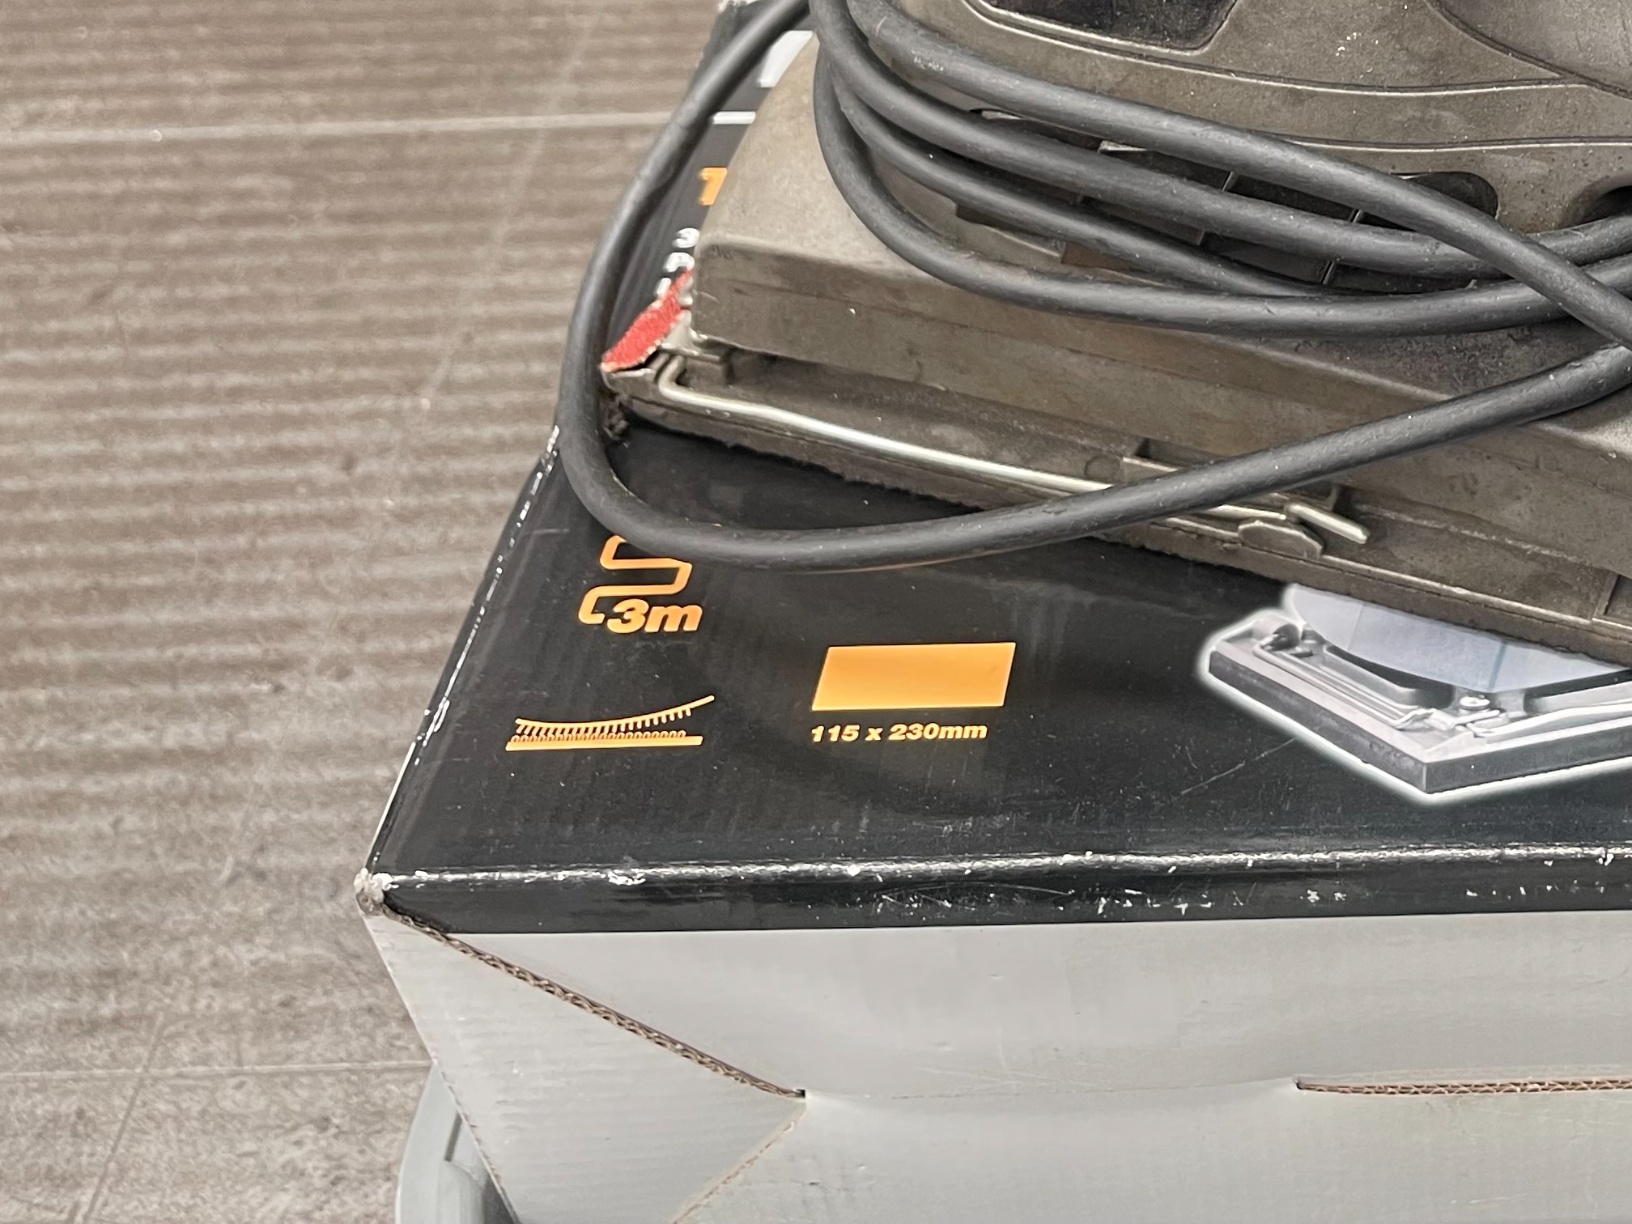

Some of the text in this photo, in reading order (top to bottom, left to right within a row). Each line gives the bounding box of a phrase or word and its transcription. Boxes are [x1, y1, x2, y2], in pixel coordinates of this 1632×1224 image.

[606, 598, 703, 634] 3m
[811, 722, 988, 743] 115 x 230mm
